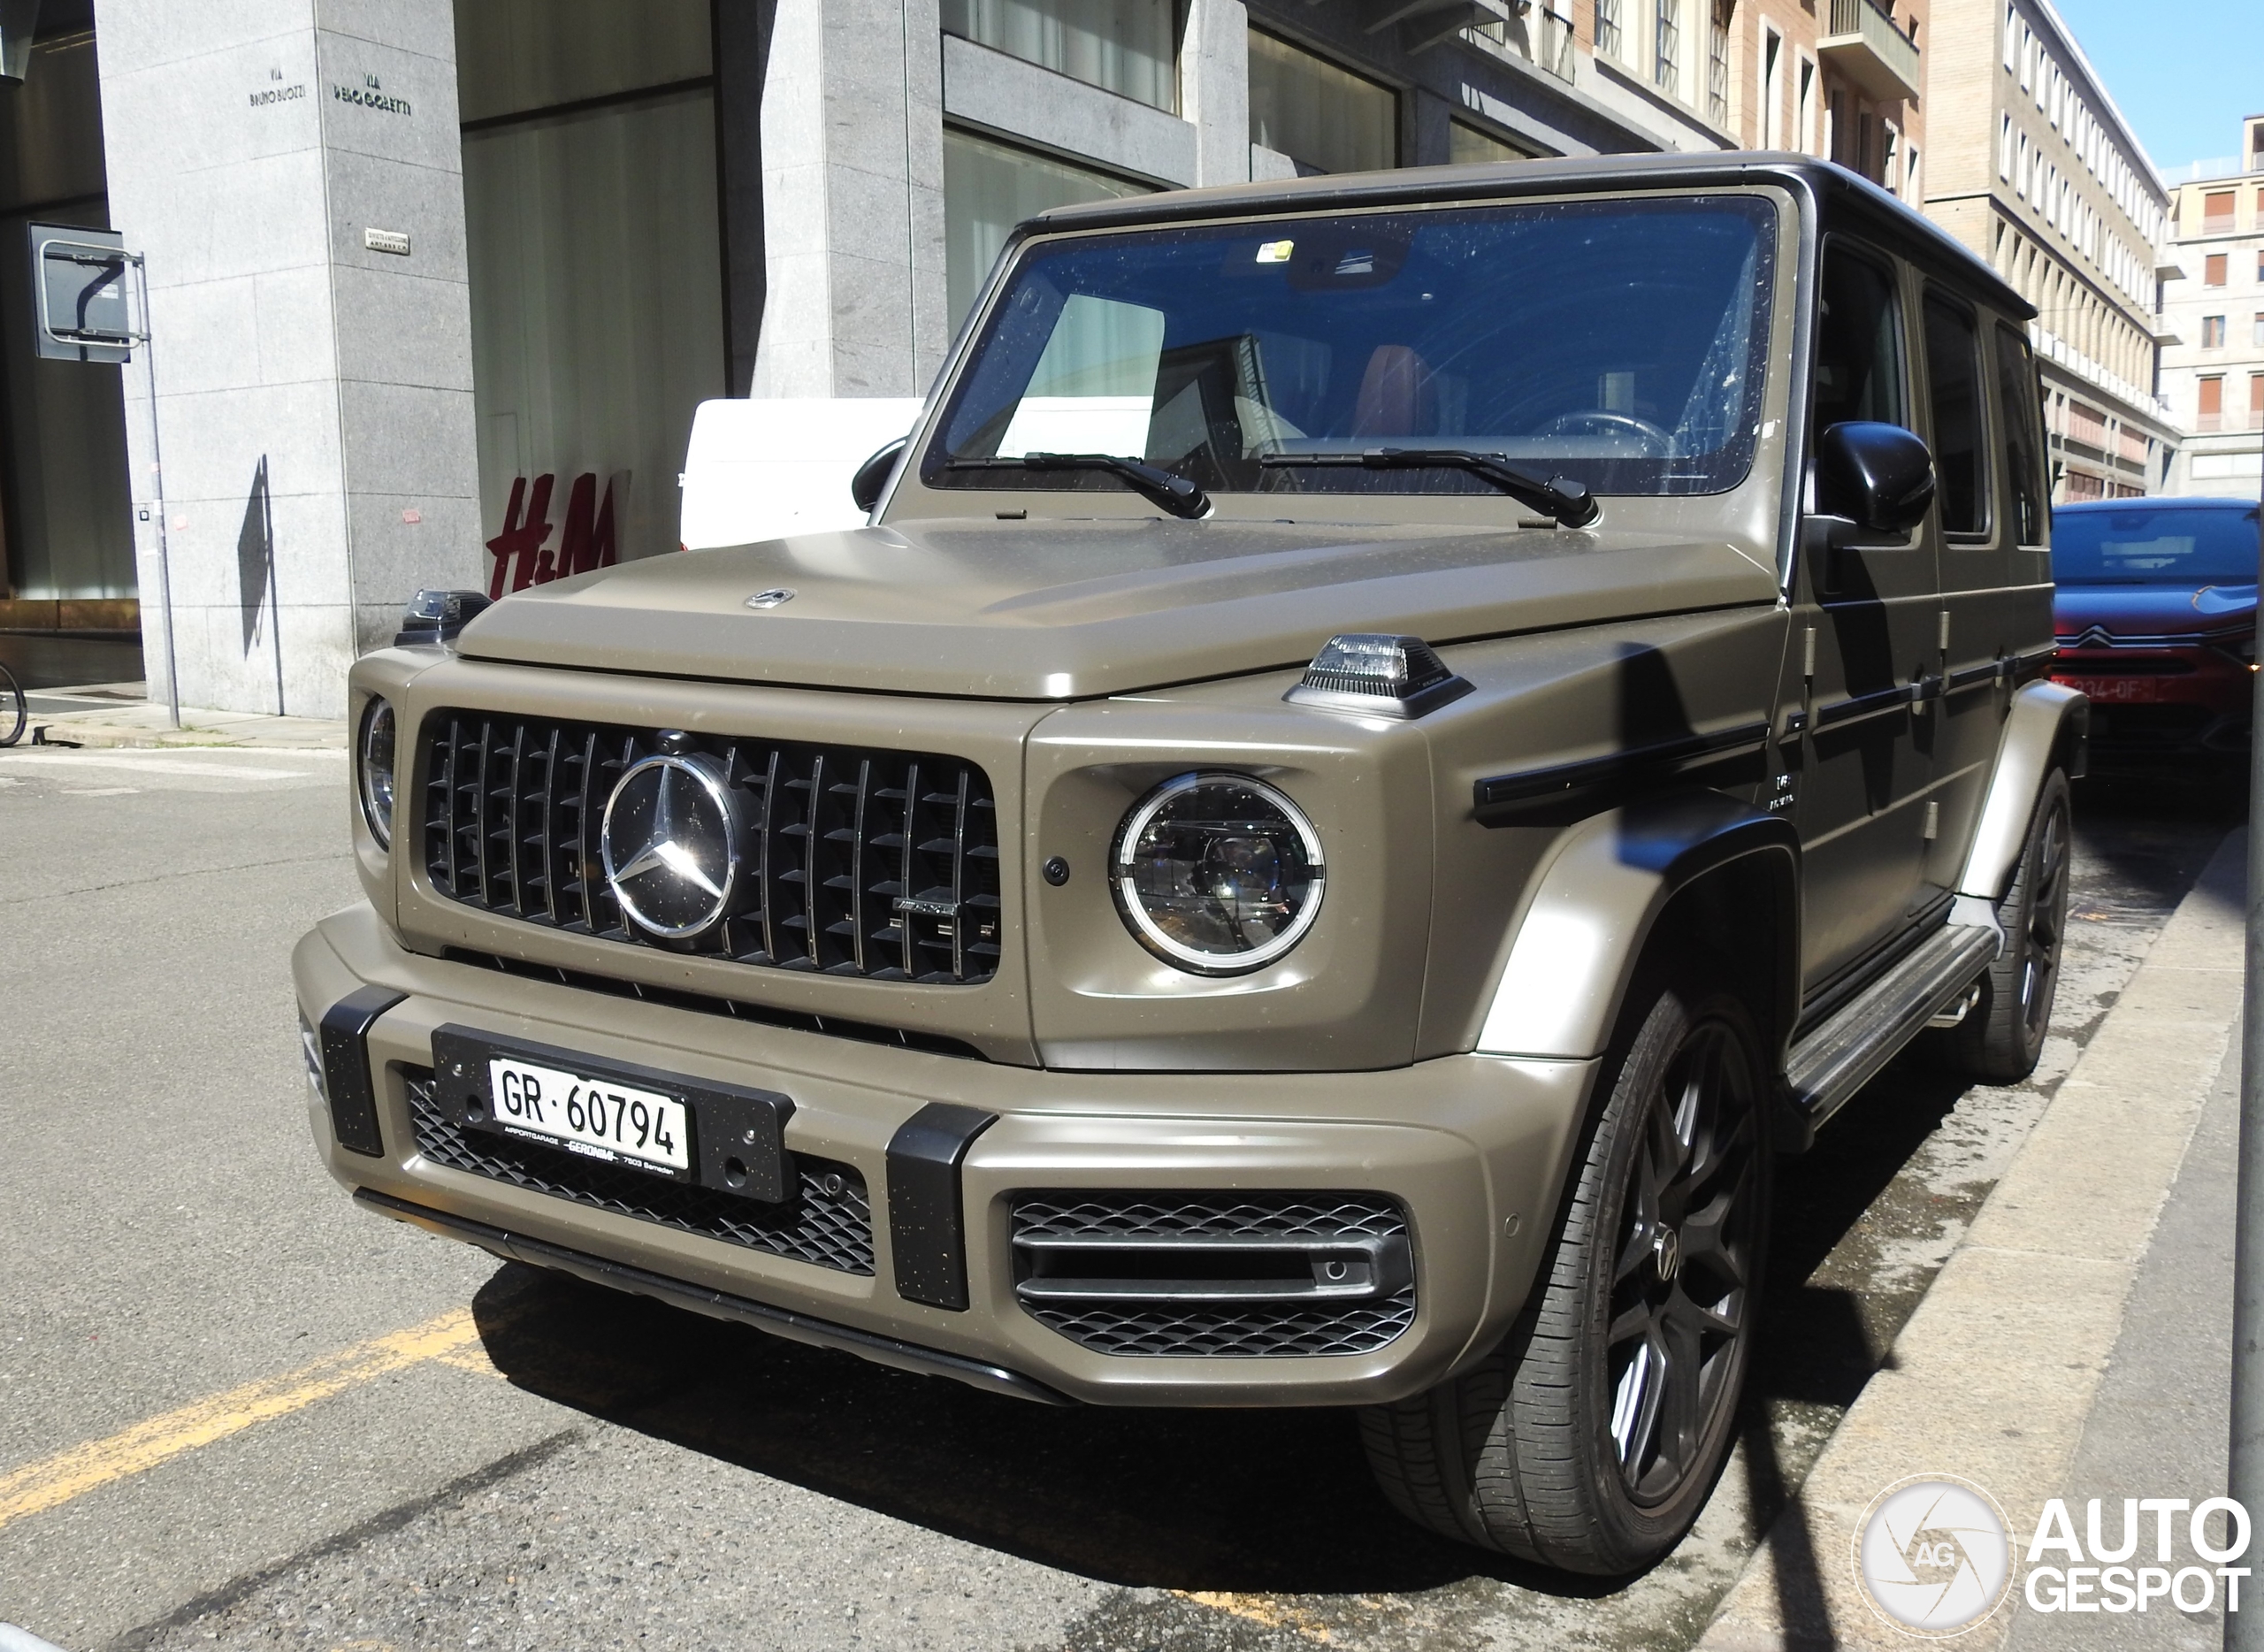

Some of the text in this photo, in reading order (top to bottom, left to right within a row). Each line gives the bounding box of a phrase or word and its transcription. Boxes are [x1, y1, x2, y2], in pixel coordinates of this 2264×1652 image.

[270, 68, 283, 81] VIA
[363, 73, 381, 90] VIA
[249, 84, 306, 107] BRUNO BUOZZI
[486, 470, 632, 602] H&M
[567, 1085, 674, 1155] 60794
